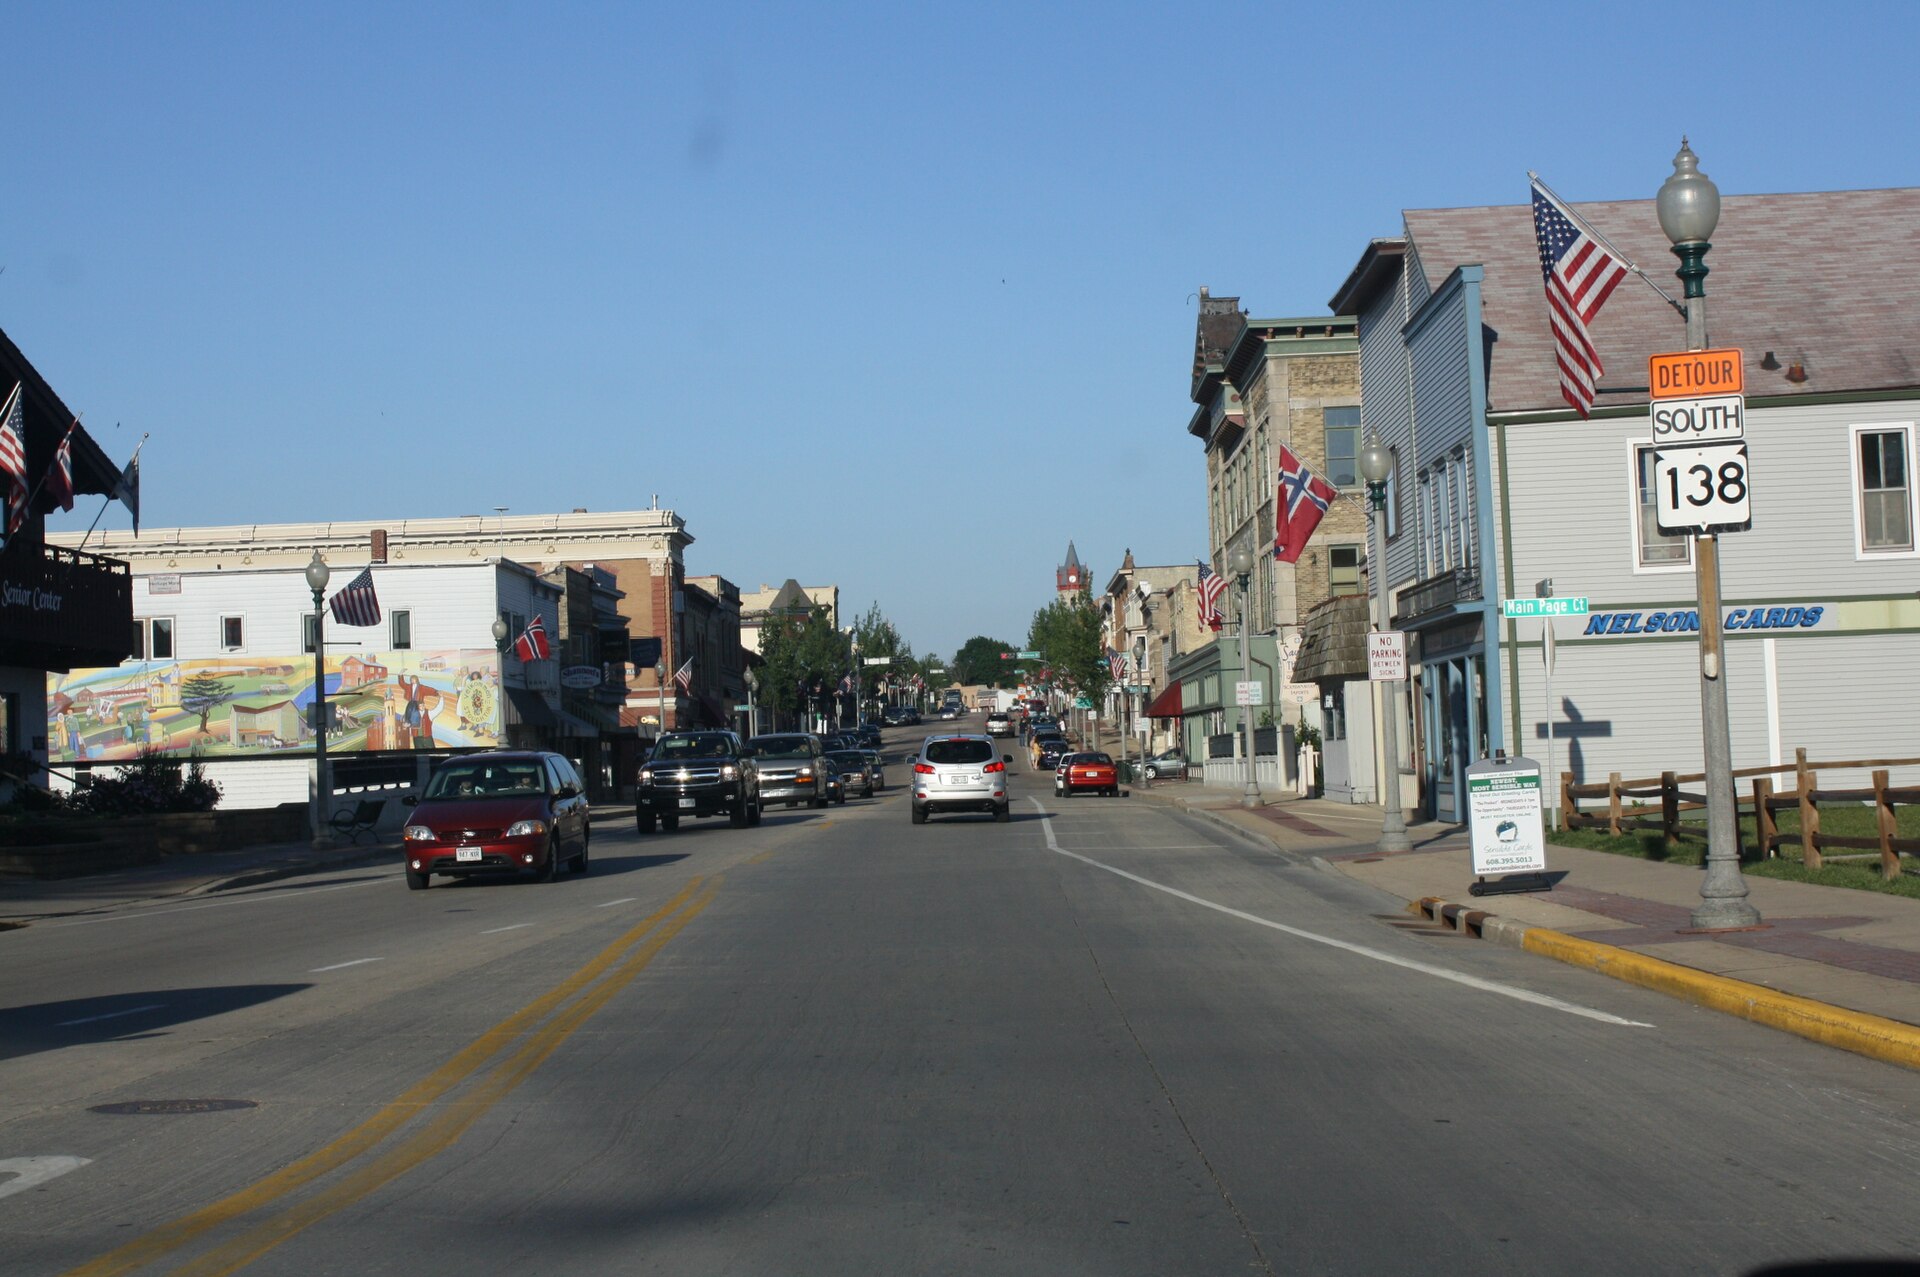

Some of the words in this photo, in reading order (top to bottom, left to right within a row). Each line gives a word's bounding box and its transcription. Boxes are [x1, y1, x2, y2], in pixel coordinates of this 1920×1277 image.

[1658, 359, 1734, 389] DETOUR
[1654, 404, 1740, 435] SOUTH
[1666, 461, 1747, 510] 138
[1, 579, 32, 607] Senior
[33, 586, 63, 611] Center
[1507, 600, 1533, 614] Main
[1539, 599, 1567, 615] Page
[1572, 598, 1585, 612] Ct
[1583, 610, 1699, 636] NELSON
[1723, 606, 1825, 630] CARDS
[1379, 636, 1392, 647] NO
[1371, 648, 1402, 659] PARKING
[1373, 660, 1401, 668] BETWEEN
[1485, 856, 1533, 866] 608.395.5013
